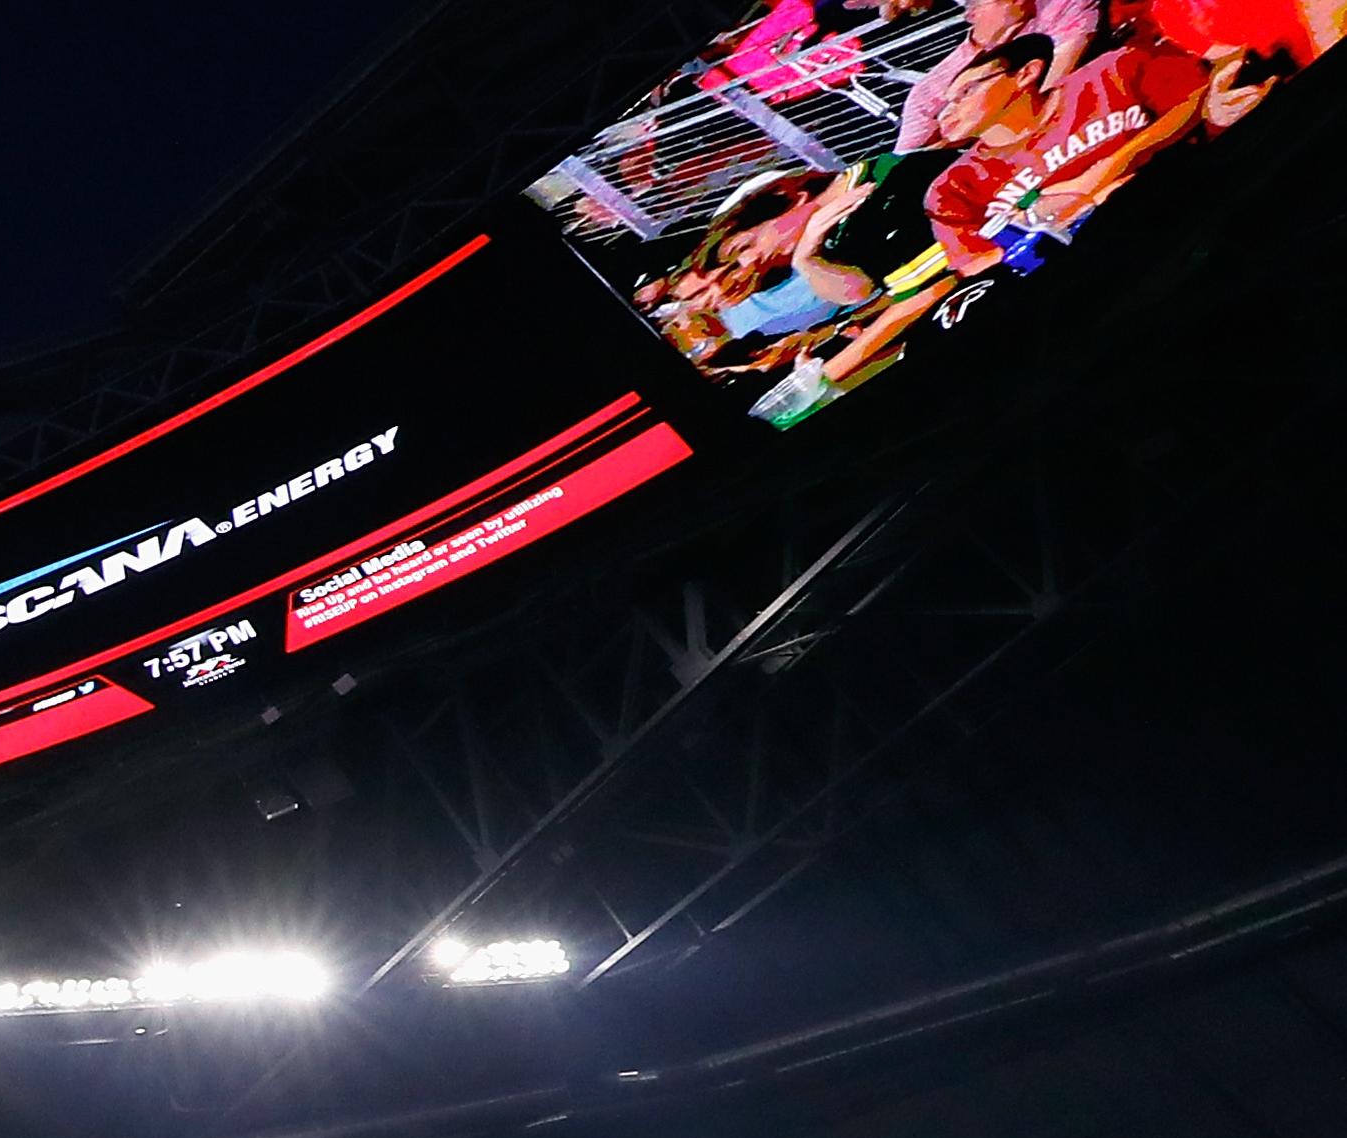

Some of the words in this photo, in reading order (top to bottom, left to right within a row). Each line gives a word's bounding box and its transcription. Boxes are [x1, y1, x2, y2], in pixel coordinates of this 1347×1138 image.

[231, 425, 399, 529] ENERGY
[299, 566, 363, 603] Social
[361, 540, 426, 575] Media
[304, 598, 358, 629] #RISEUP
[360, 591, 379, 604] on
[378, 559, 449, 595] Instagram
[448, 543, 477, 563] and
[475, 519, 527, 548] Twitter
[325, 592, 346, 606] Up
[346, 578, 373, 597] and
[371, 572, 392, 584] be
[390, 550, 433, 576] heard
[482, 517, 504, 531] by
[504, 486, 564, 521] utilizing
[143, 640, 203, 680] 7:57
[208, 620, 257, 658] PM
